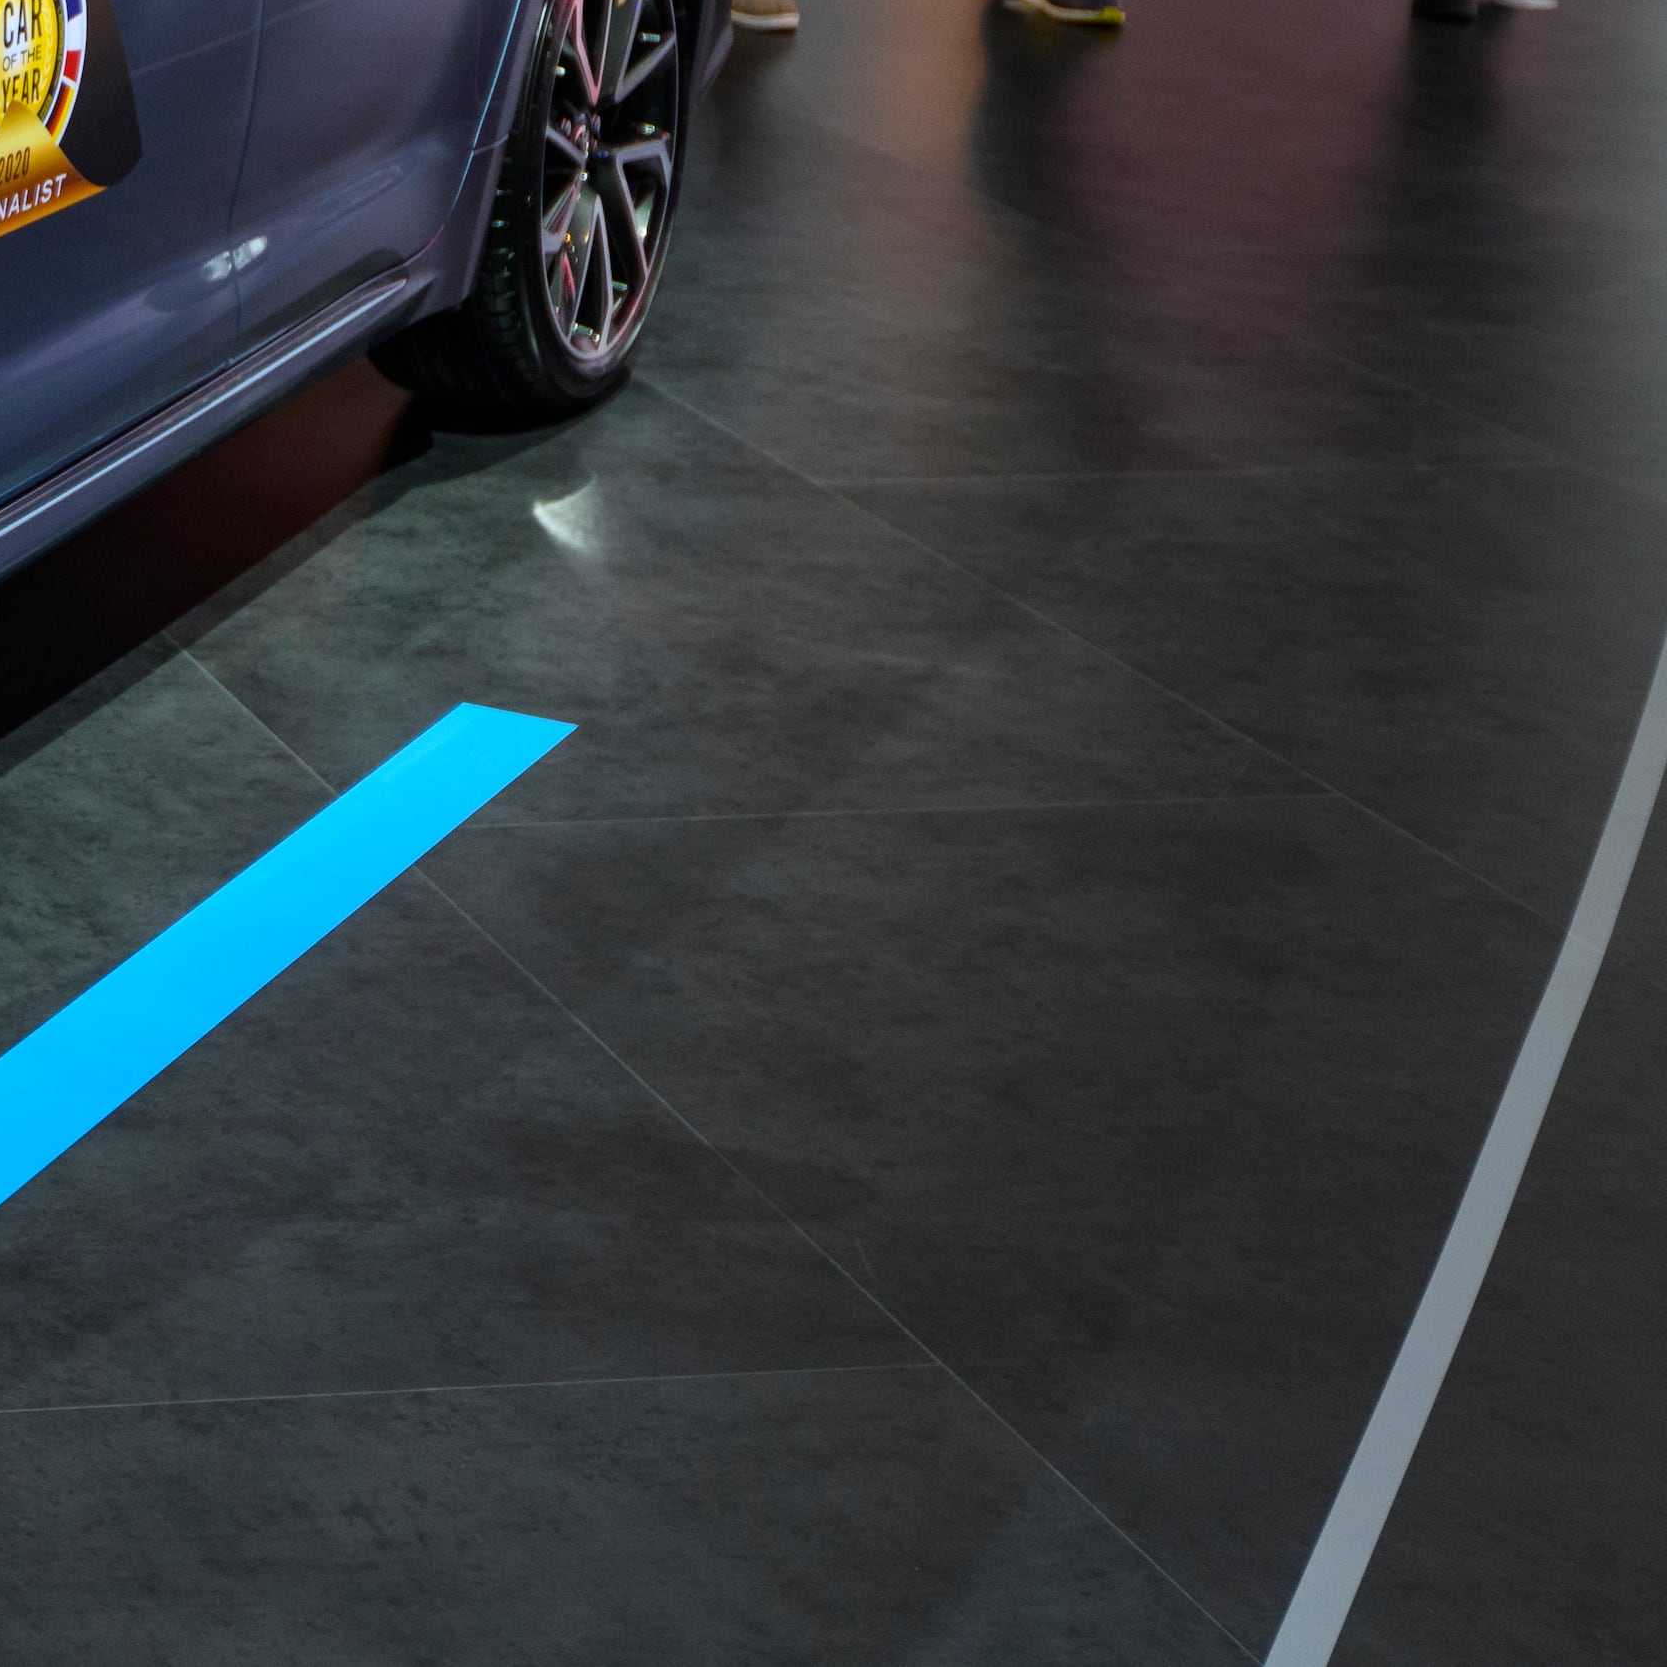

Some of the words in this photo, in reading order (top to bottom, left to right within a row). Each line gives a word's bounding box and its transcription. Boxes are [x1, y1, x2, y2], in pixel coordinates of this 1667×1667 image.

[2, 53, 18, 73] OF
[20, 45, 43, 68] THE
[2, 67, 42, 114] YEAR
